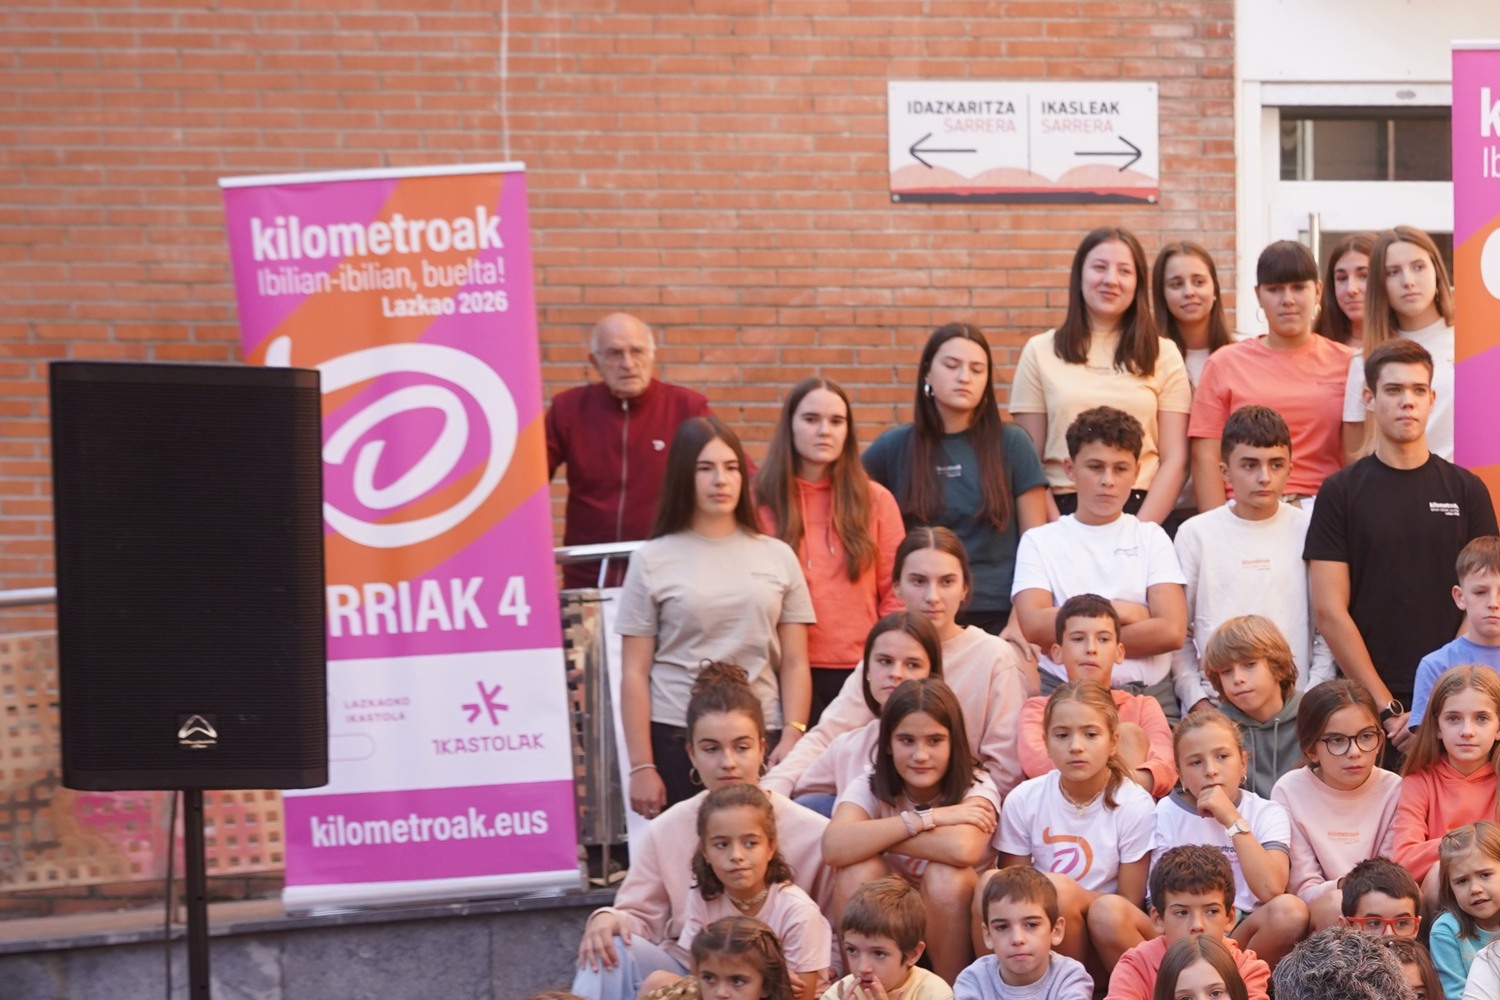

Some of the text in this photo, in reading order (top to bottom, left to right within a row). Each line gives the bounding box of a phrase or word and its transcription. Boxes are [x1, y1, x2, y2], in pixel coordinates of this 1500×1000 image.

[907, 101, 1016, 115] IDAZKARITZA
[1041, 101, 1120, 115] IKASLEAK
[943, 118, 1017, 133] SARRERA
[1040, 118, 1114, 133] SARRERA
[251, 204, 504, 261] kilometroak
[257, 256, 506, 296] Ibilian-ibilian, buelta!
[382, 290, 509, 317] Lazkao 2026
[326, 576, 531, 637] RRIAK 4
[432, 733, 545, 755] IKASTOLAK
[311, 807, 549, 848] kilometroak.eus
